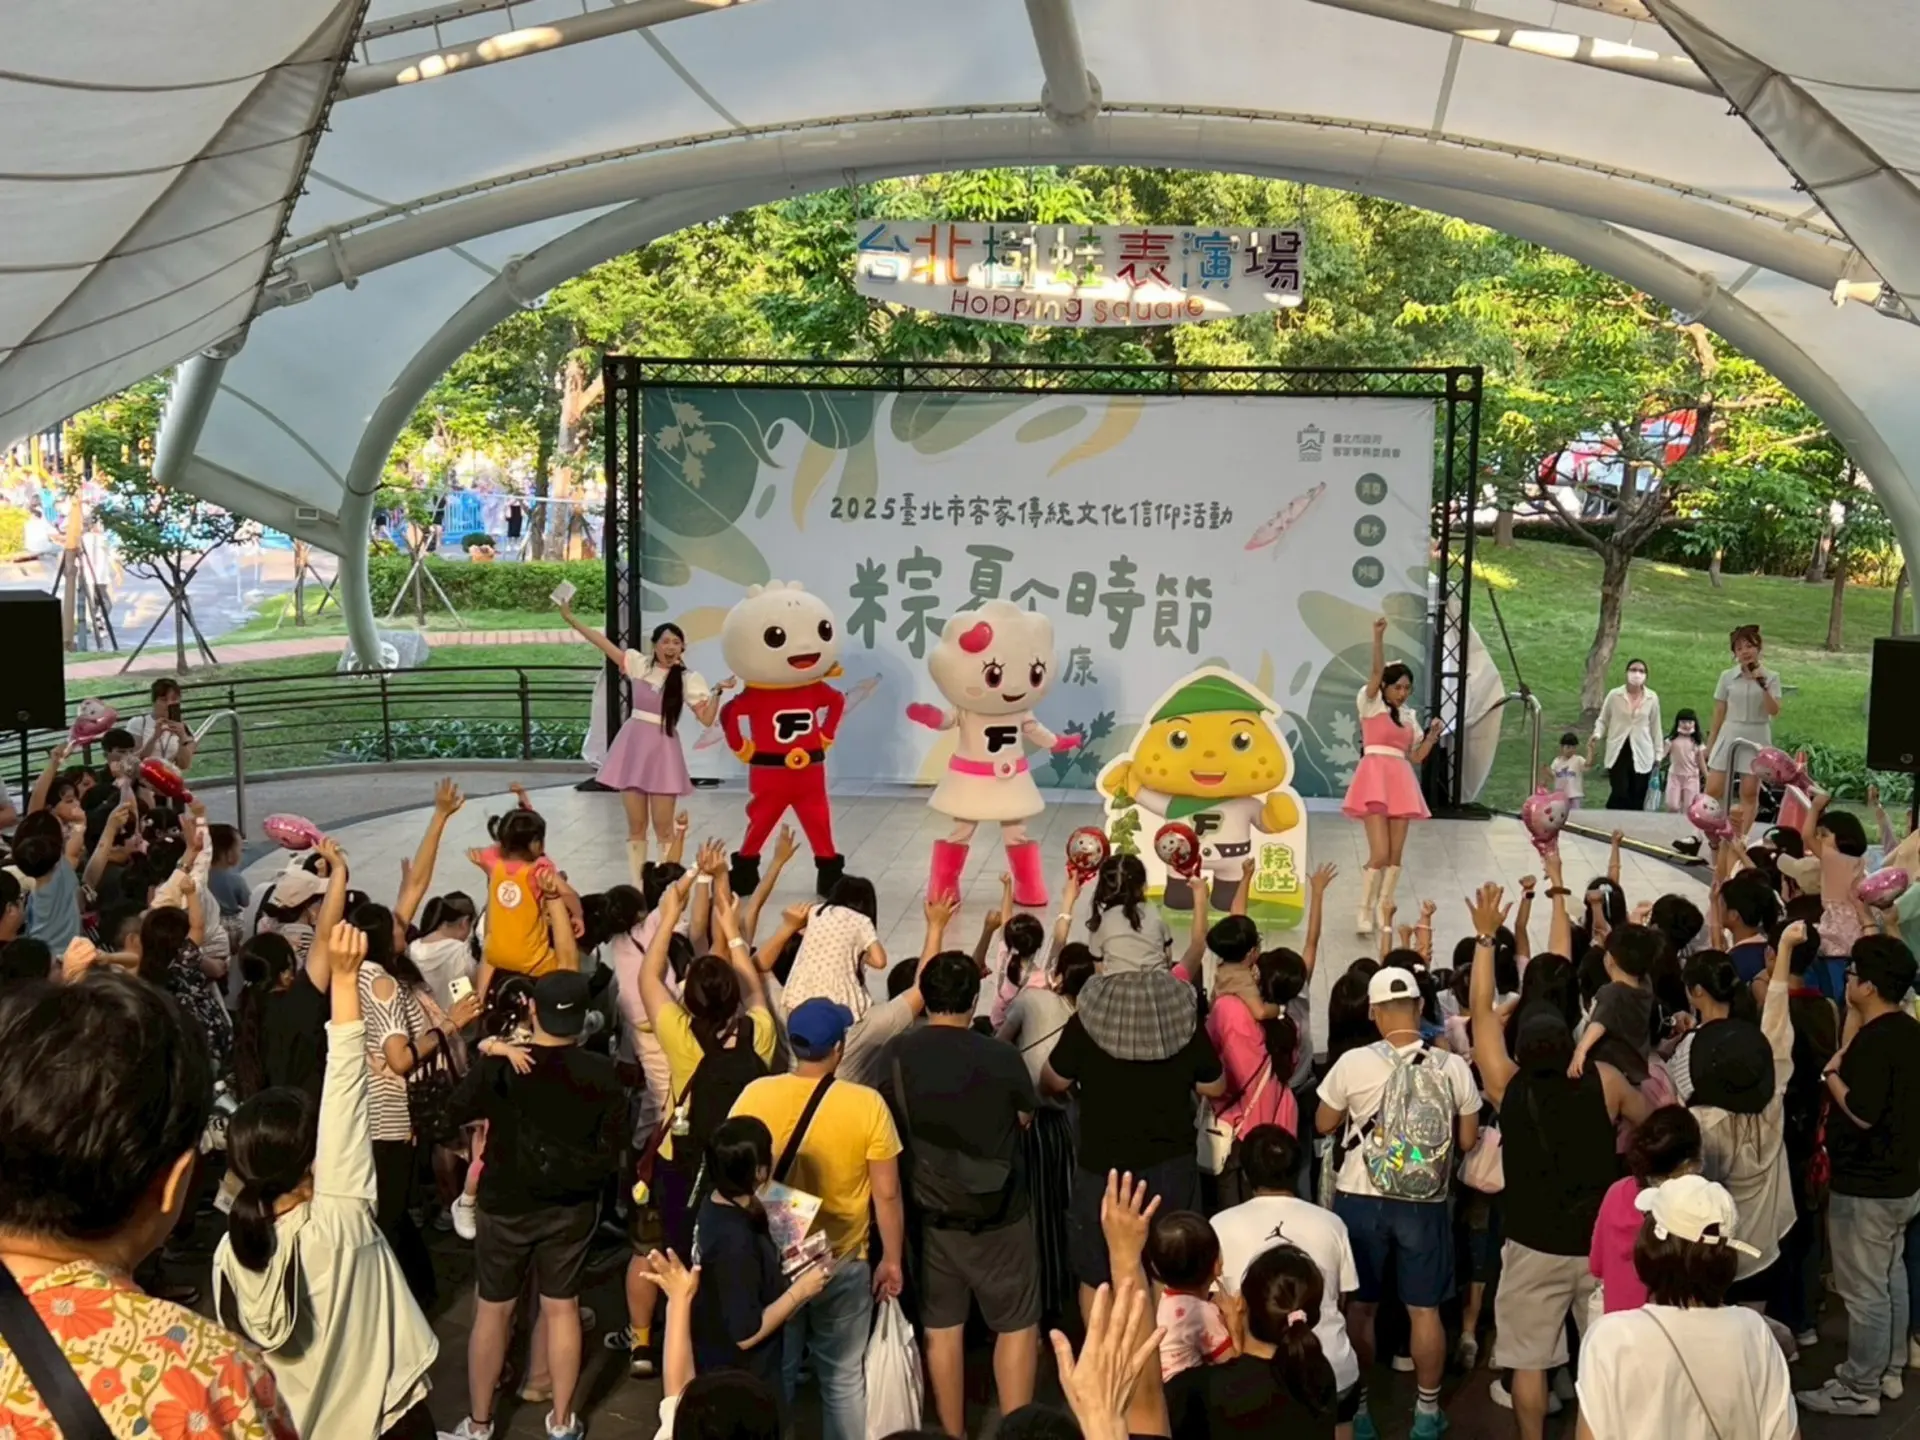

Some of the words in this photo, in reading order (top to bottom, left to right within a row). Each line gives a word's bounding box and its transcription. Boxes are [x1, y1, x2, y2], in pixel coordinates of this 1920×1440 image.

[951, 289, 1083, 323] Hopping
[1094, 295, 1205, 326] square
[830, 493, 1234, 530] 2025臺北市客家傳統文化信仰活動
[776, 712, 811, 741] F
[984, 725, 1018, 753] F
[1193, 813, 1222, 836] F
